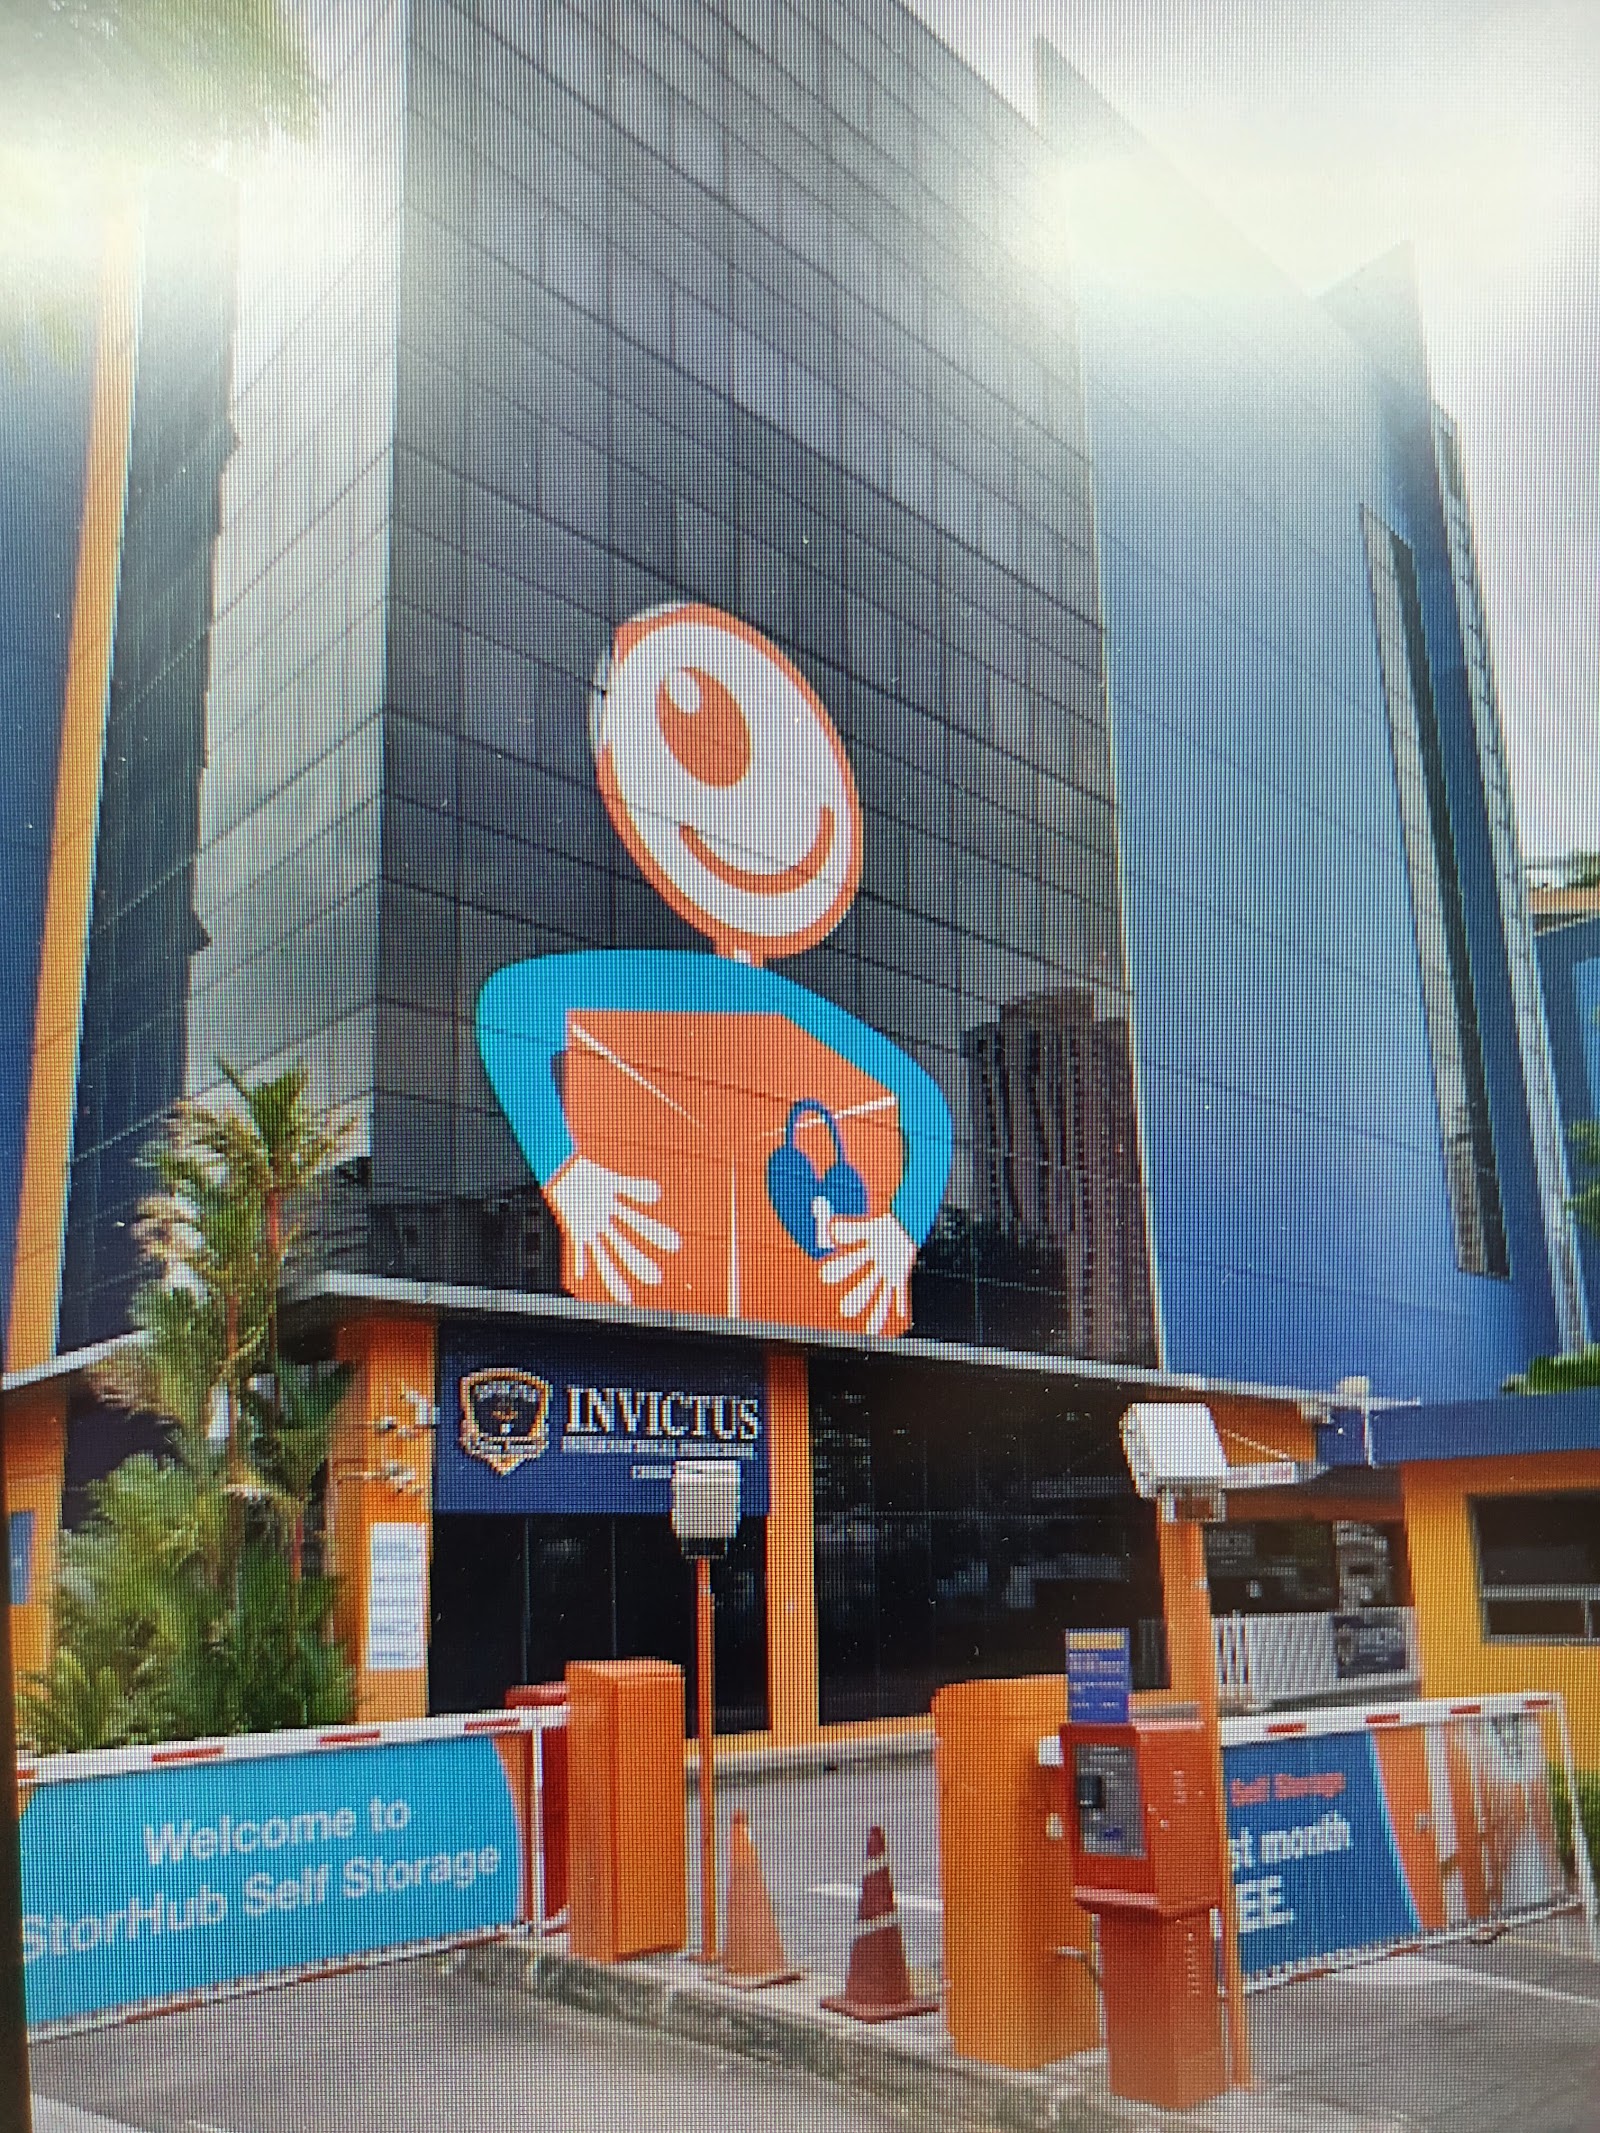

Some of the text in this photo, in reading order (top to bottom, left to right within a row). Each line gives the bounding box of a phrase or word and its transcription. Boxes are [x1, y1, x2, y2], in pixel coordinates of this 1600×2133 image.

[565, 1383, 760, 1440] INVICTUS
[142, 1797, 411, 1865] Welcome to
[1261, 1810, 1353, 1864] month
[22, 1844, 500, 1961] StorHub Self Storage
